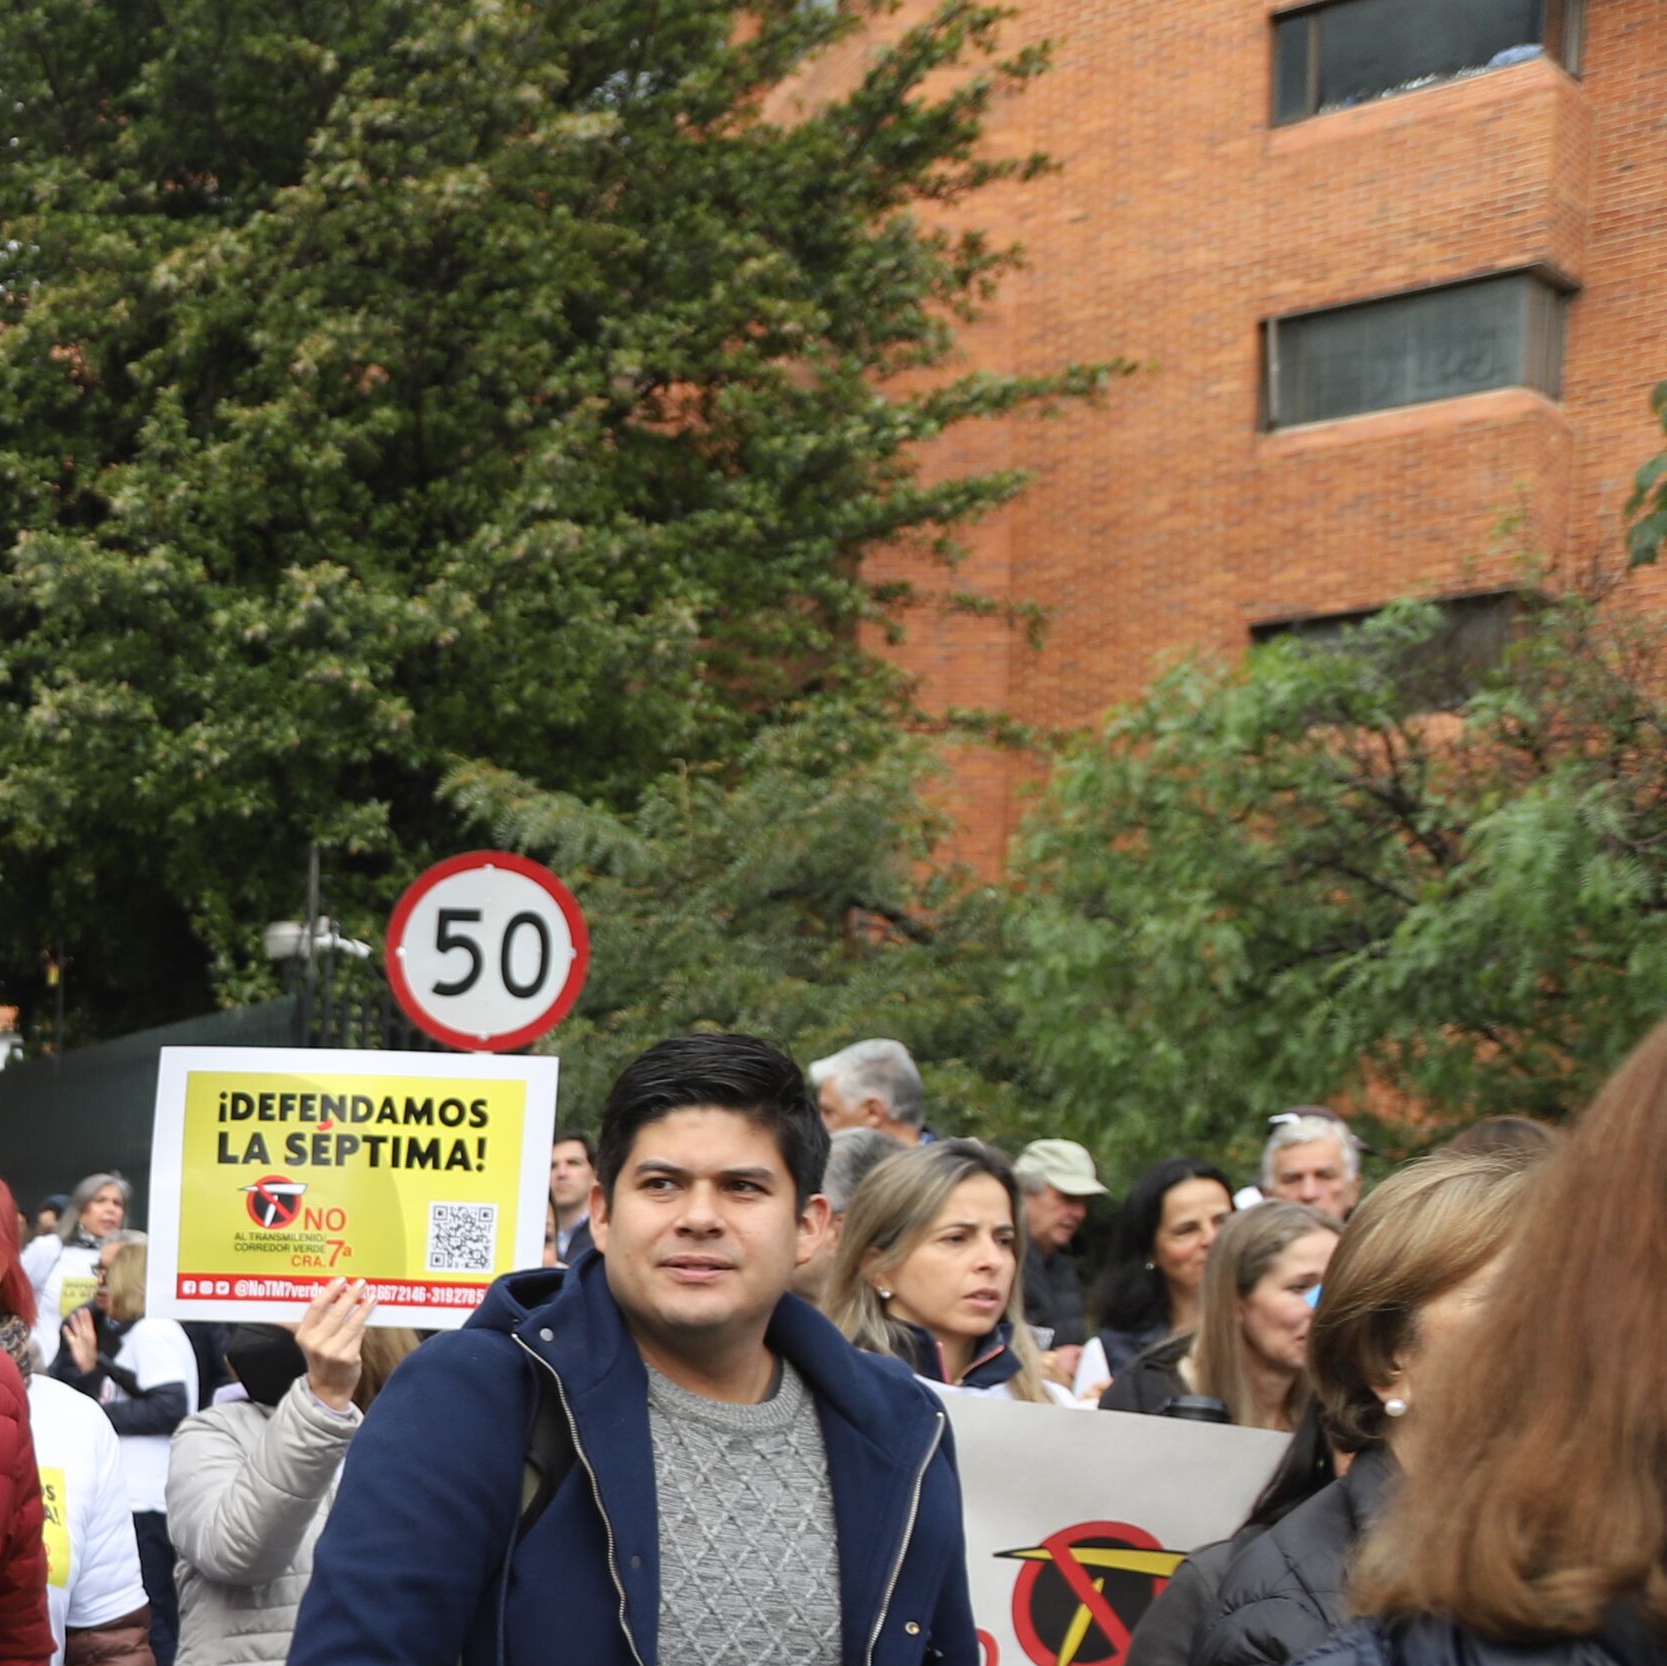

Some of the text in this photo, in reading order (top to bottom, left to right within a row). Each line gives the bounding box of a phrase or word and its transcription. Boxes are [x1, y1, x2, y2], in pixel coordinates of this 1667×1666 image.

[432, 909, 551, 998] 50
[219, 1090, 489, 1128] ¡DEFENDAMOS
[218, 1120, 488, 1173] LA SÉPTIMA!
[304, 1208, 346, 1231] NO
[234, 1232, 247, 1241] AL
[234, 1242, 325, 1254] CORREDOR VERDE
